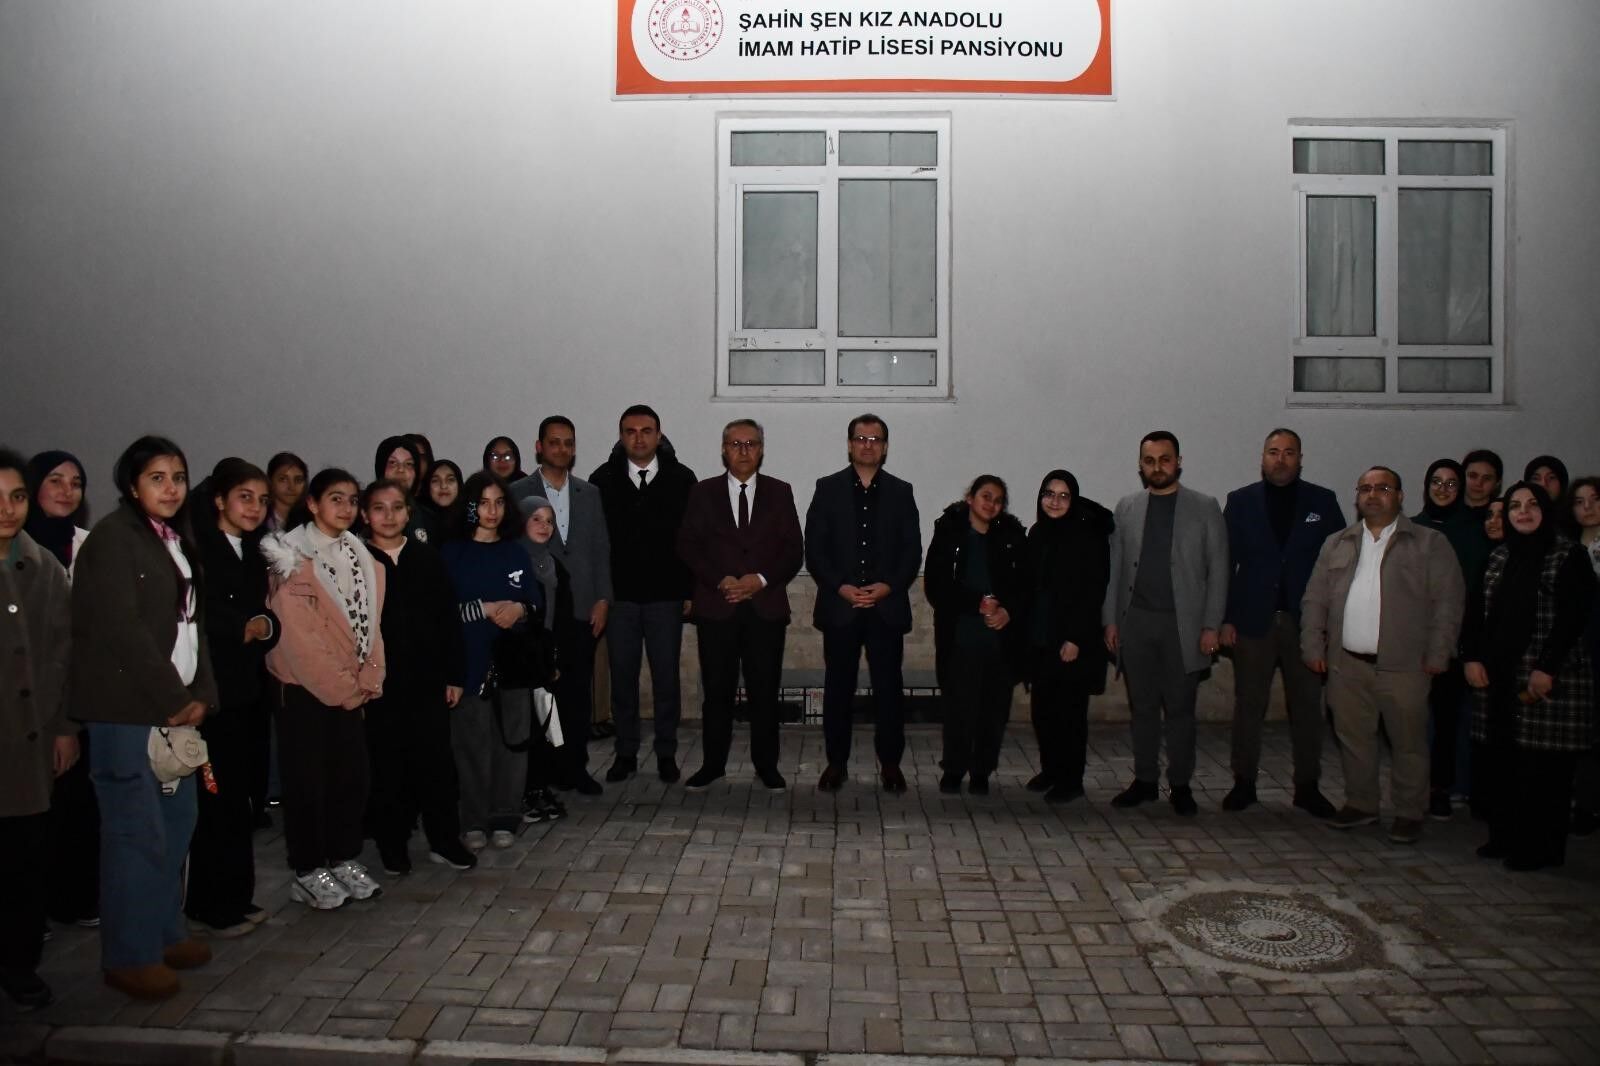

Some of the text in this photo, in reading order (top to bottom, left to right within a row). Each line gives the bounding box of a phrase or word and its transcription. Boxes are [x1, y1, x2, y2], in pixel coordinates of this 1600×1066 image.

[738, 9, 1002, 32] ŞAHİN ŞEN KIZ ANADOLU
[738, 36, 1063, 58] İMAM HATİP LİSESİ PANSİYONU
